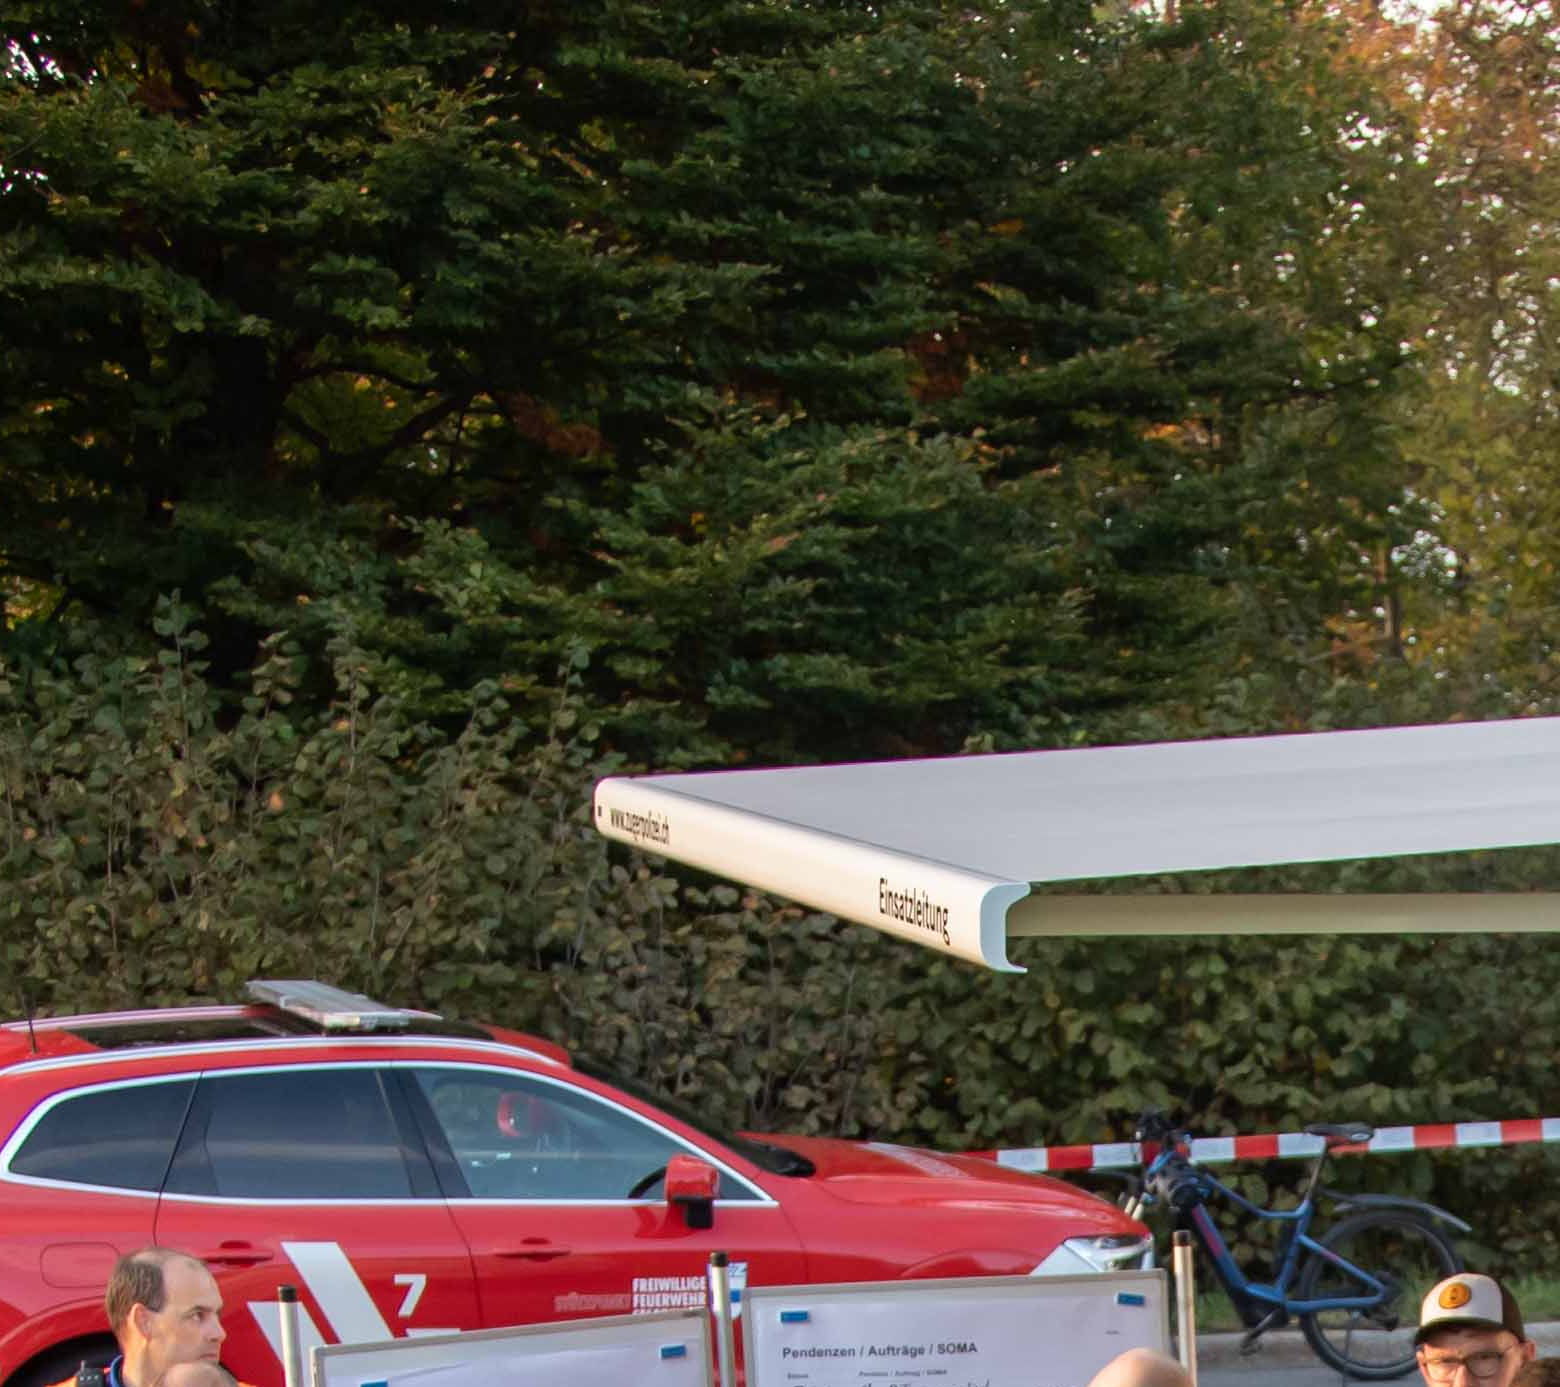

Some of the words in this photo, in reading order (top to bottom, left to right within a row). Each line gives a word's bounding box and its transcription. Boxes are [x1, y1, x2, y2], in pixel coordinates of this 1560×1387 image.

[878, 877, 951, 946] Einsatzleitung
[632, 1276, 706, 1292] FREIWILLIGE
[393, 1273, 427, 1317] 7
[632, 1291, 706, 1309] FEUERWEHR
[782, 1346, 856, 1360] Pendenzen
[868, 1344, 925, 1358] Aufträge
[937, 1342, 978, 1355] SOMA
